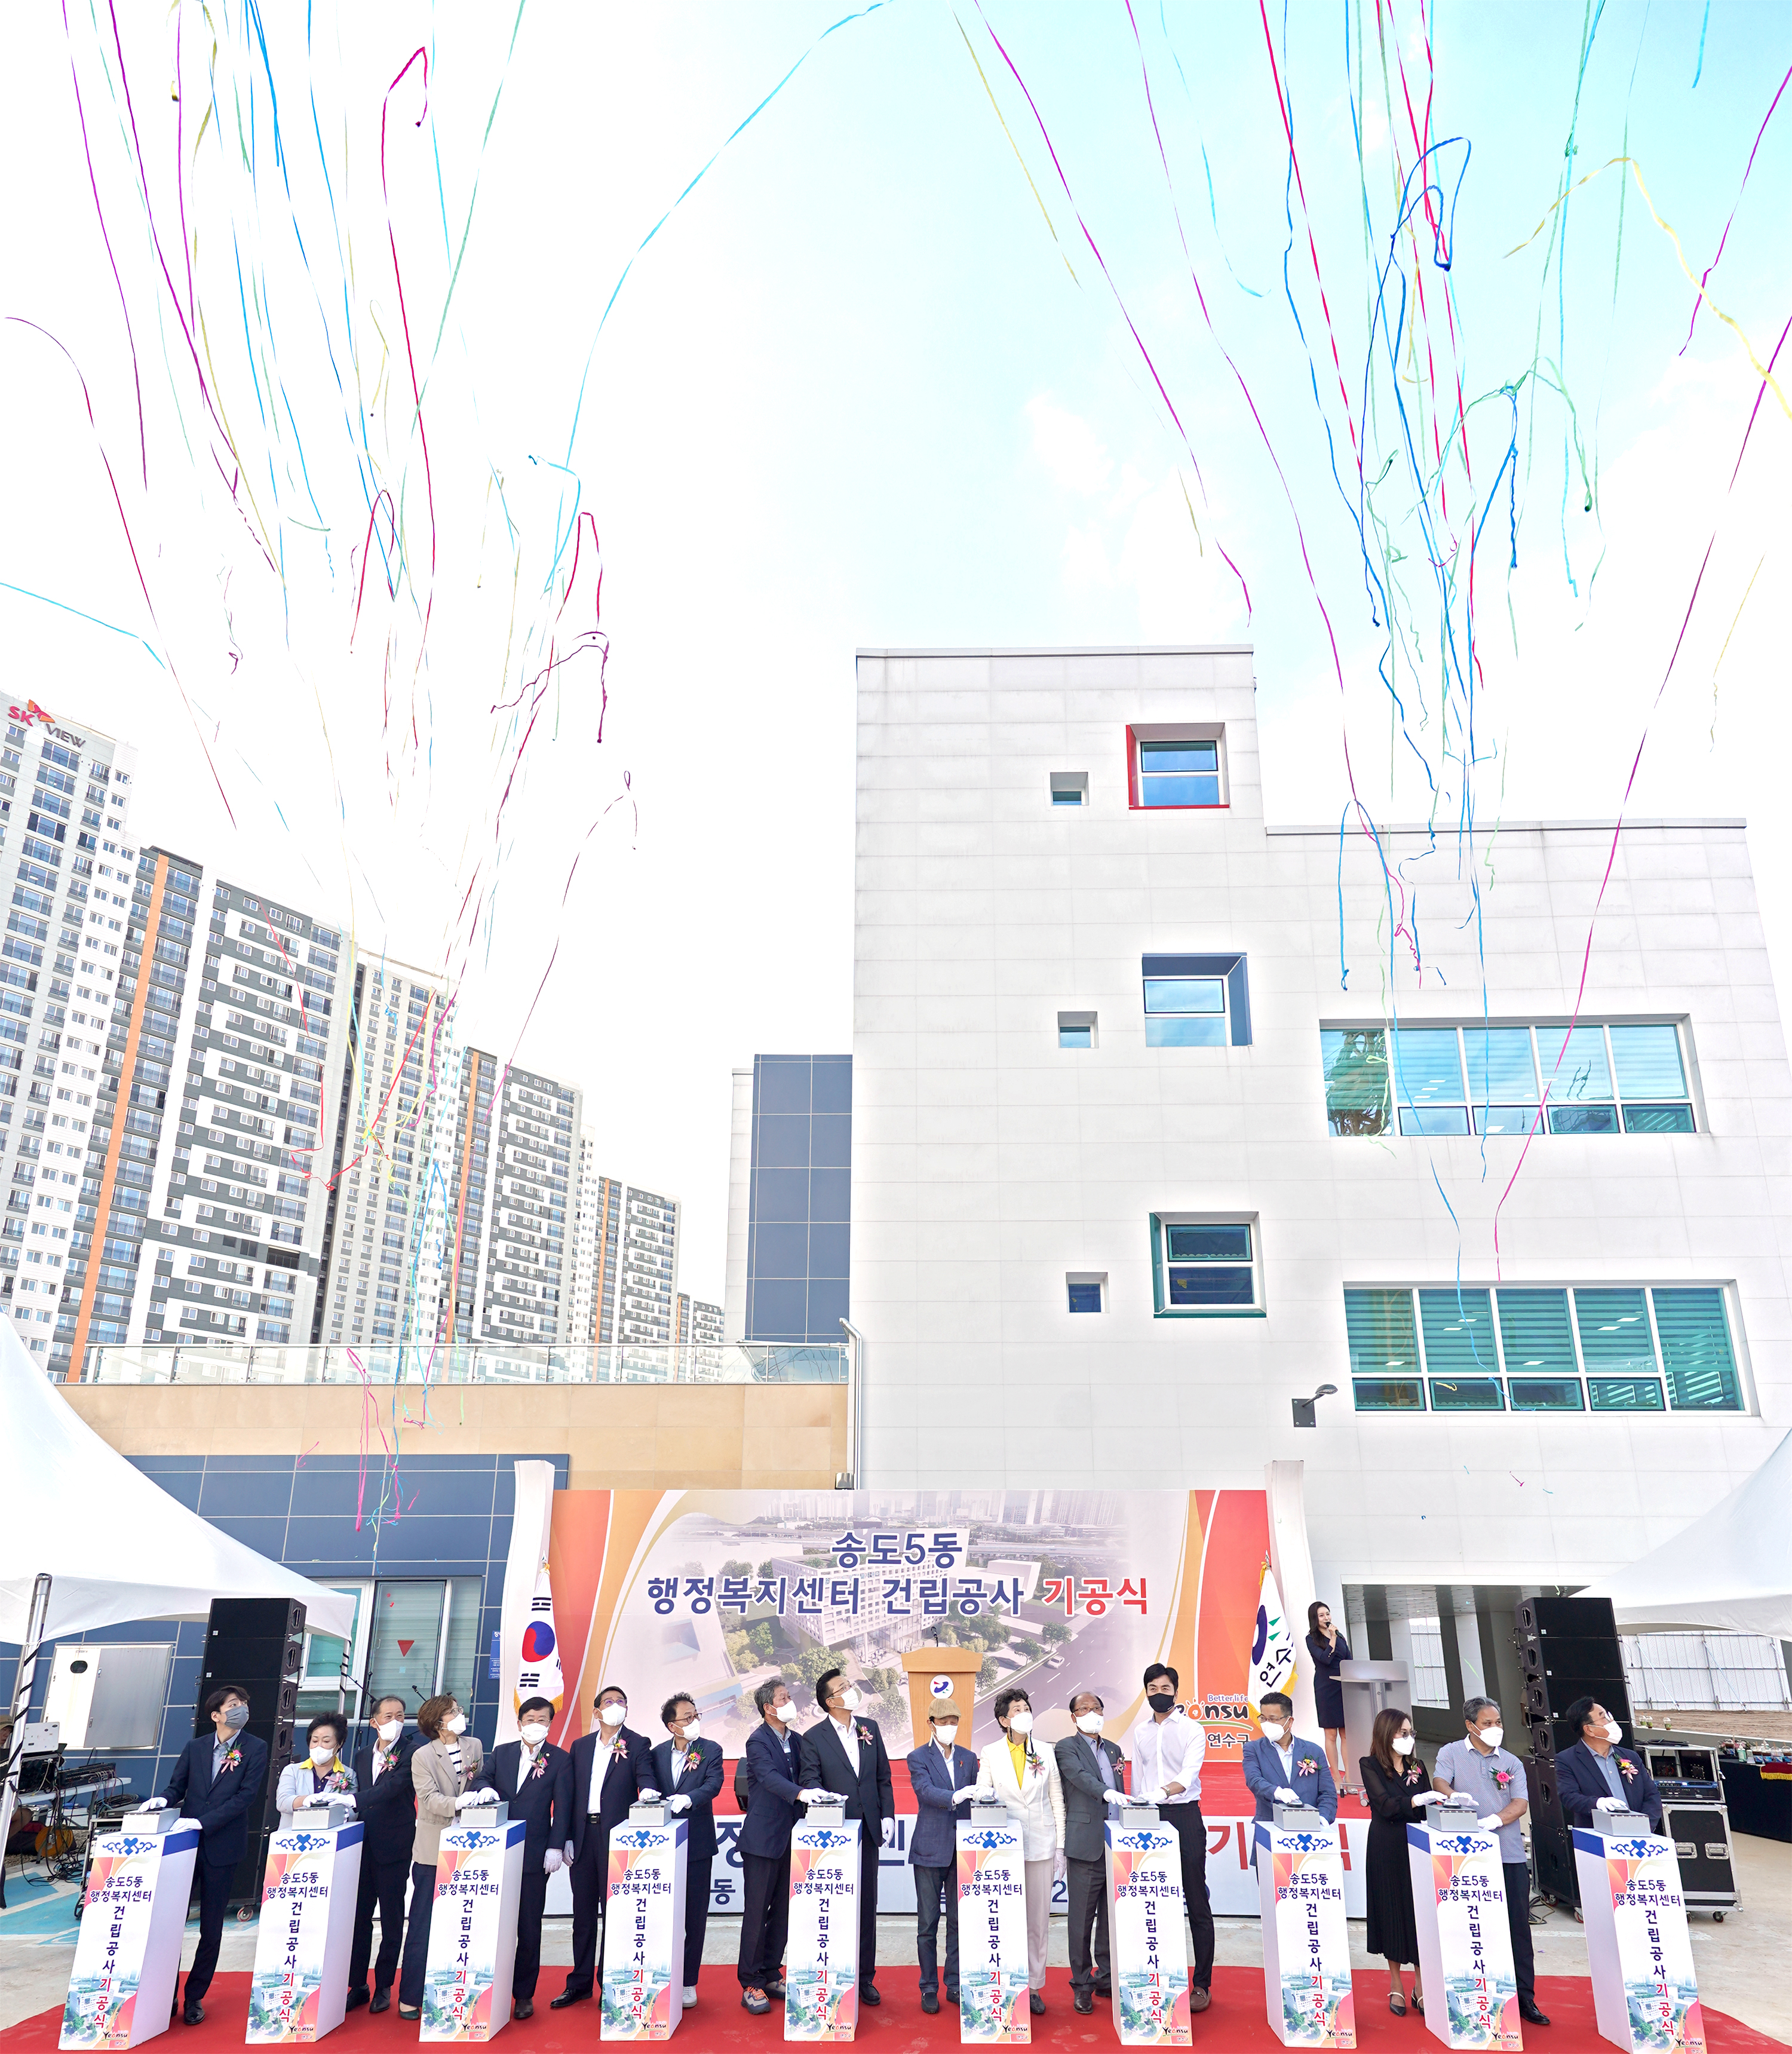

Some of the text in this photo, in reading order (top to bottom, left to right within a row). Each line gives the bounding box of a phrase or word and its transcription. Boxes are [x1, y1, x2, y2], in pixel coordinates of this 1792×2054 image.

[8, 706, 86, 748] SK VIEW
[831, 1531, 962, 1569] 송도5동
[648, 1577, 1147, 1615] 행정복지센터 건립공사 기공식
[281, 1872, 318, 1883] 송도5동
[452, 1869, 489, 1881] 송도5동
[624, 1869, 661, 1880] 송도5동
[806, 1869, 843, 1880] 송도5동
[973, 1870, 1011, 1881] 송도5동
[1130, 1871, 1167, 1883] 송도5동
[1290, 1874, 1328, 1885] 송도5동
[105, 1876, 143, 1887] 송도5동
[1450, 1875, 1489, 1887] 송도5동
[1626, 1880, 1666, 1891] 송도5동
[267, 1886, 328, 1898] 행정복지센터
[438, 1884, 499, 1895] 행정복지센터
[610, 1883, 671, 1894] 행정복지센터
[793, 1883, 854, 1894] 행정복지센터
[961, 1884, 1022, 1896] 행정복지센터
[1118, 1885, 1179, 1897] 행정복지센터
[1278, 1887, 1341, 1899] 행정복지센터
[90, 1891, 151, 1902] 행정복지센터
[1438, 1889, 1502, 1902] 행정복지센터
[1615, 1893, 1681, 1906] 행정복지센터
